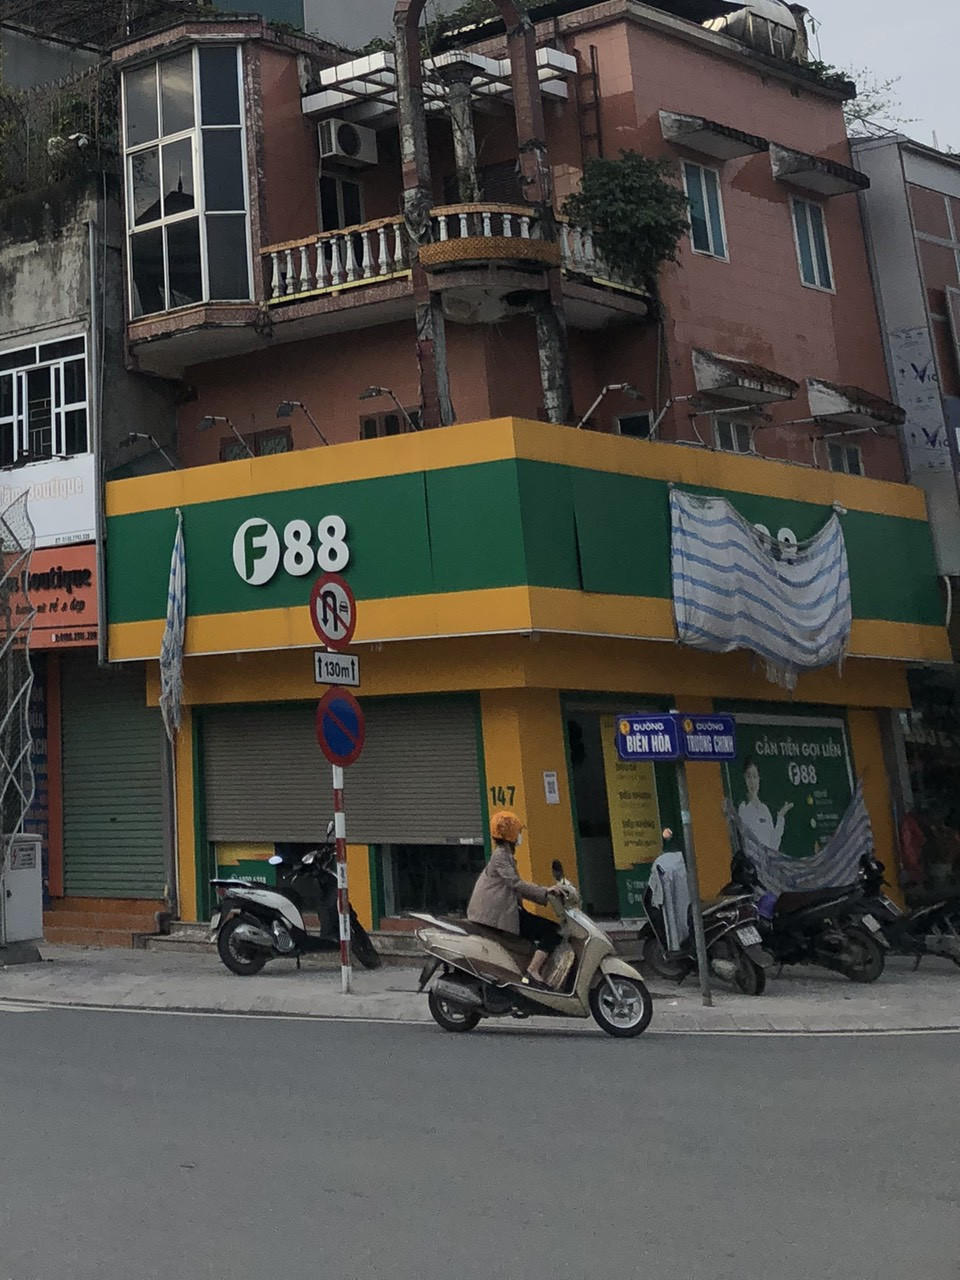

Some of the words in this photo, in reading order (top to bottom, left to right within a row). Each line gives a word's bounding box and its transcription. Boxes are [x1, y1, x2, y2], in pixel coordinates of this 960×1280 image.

[233, 515, 350, 586] F88
[324, 662, 350, 678] 130m
[633, 721, 664, 731] ĐƯỜNG
[695, 721, 724, 731] ĐƯỜNG
[626, 734, 649, 753] BIÊN
[651, 732, 672, 753] HÒA
[714, 736, 734, 753] CHINH
[801, 743, 820, 760] GỌI
[490, 786, 515, 807] 147
